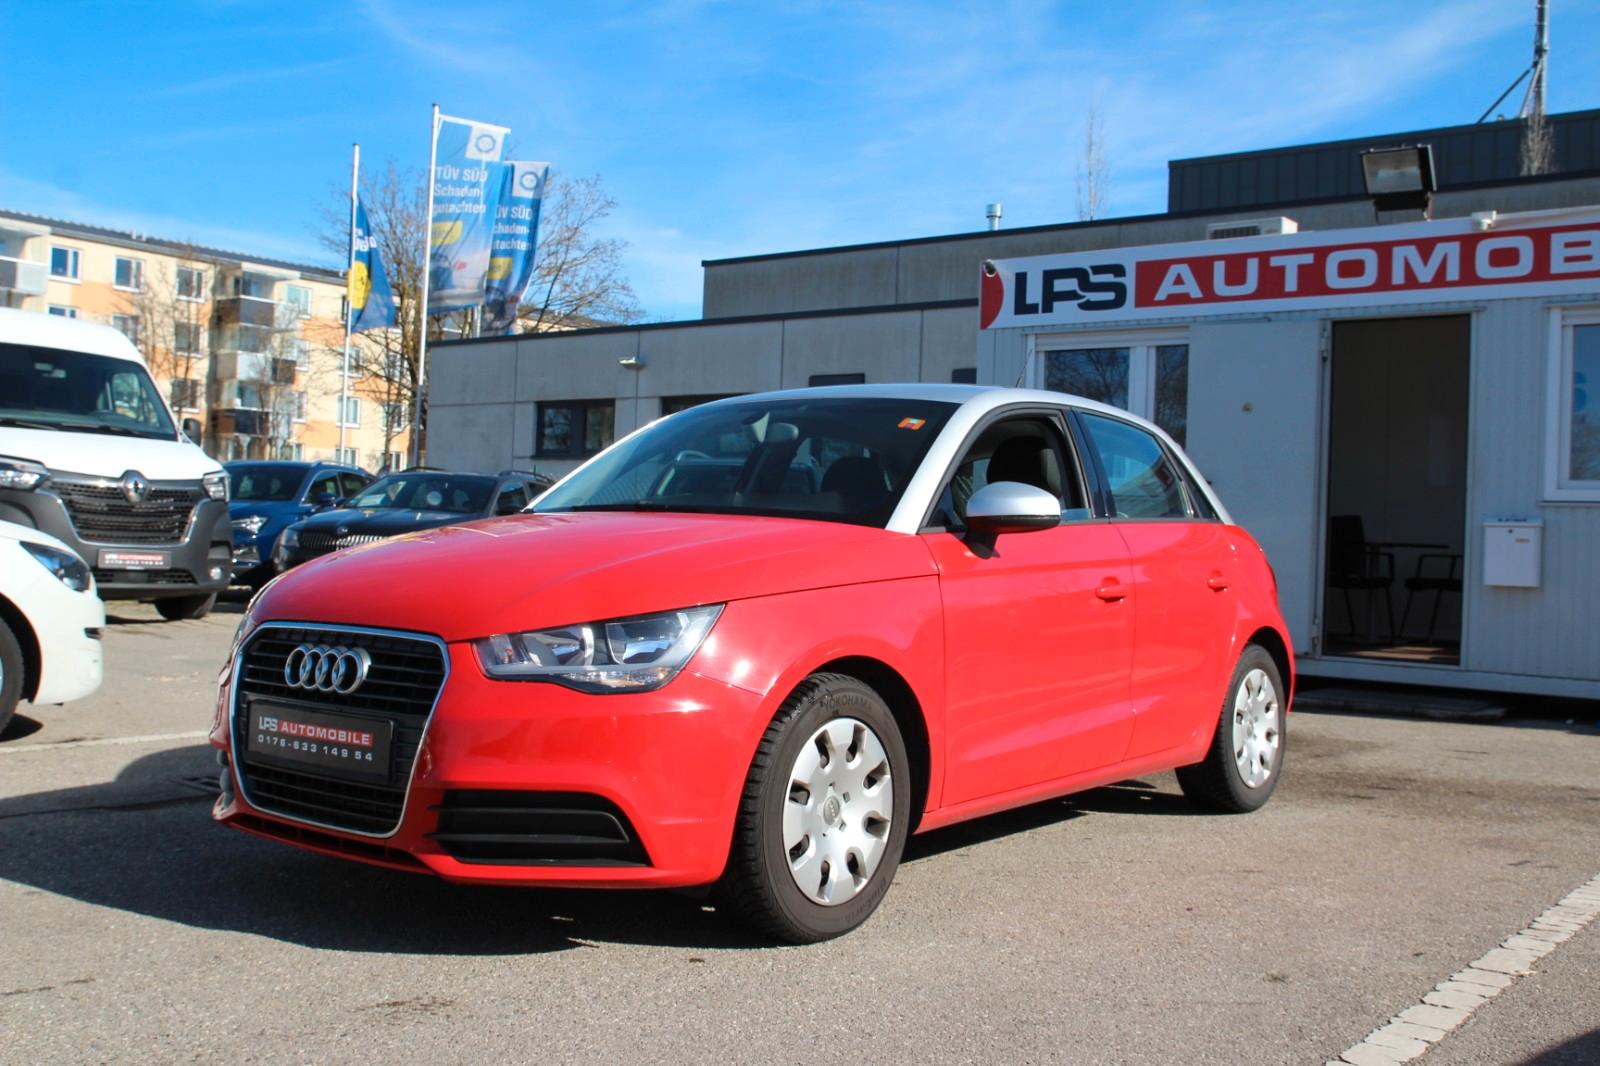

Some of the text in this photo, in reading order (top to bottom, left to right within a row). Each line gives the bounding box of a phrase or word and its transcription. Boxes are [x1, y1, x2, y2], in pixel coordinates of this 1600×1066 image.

[436, 165, 488, 183] TÜV SÜD
[1013, 229, 1600, 316] LPS AUTOMOB
[258, 716, 371, 745] LPS AUTOMOBILE
